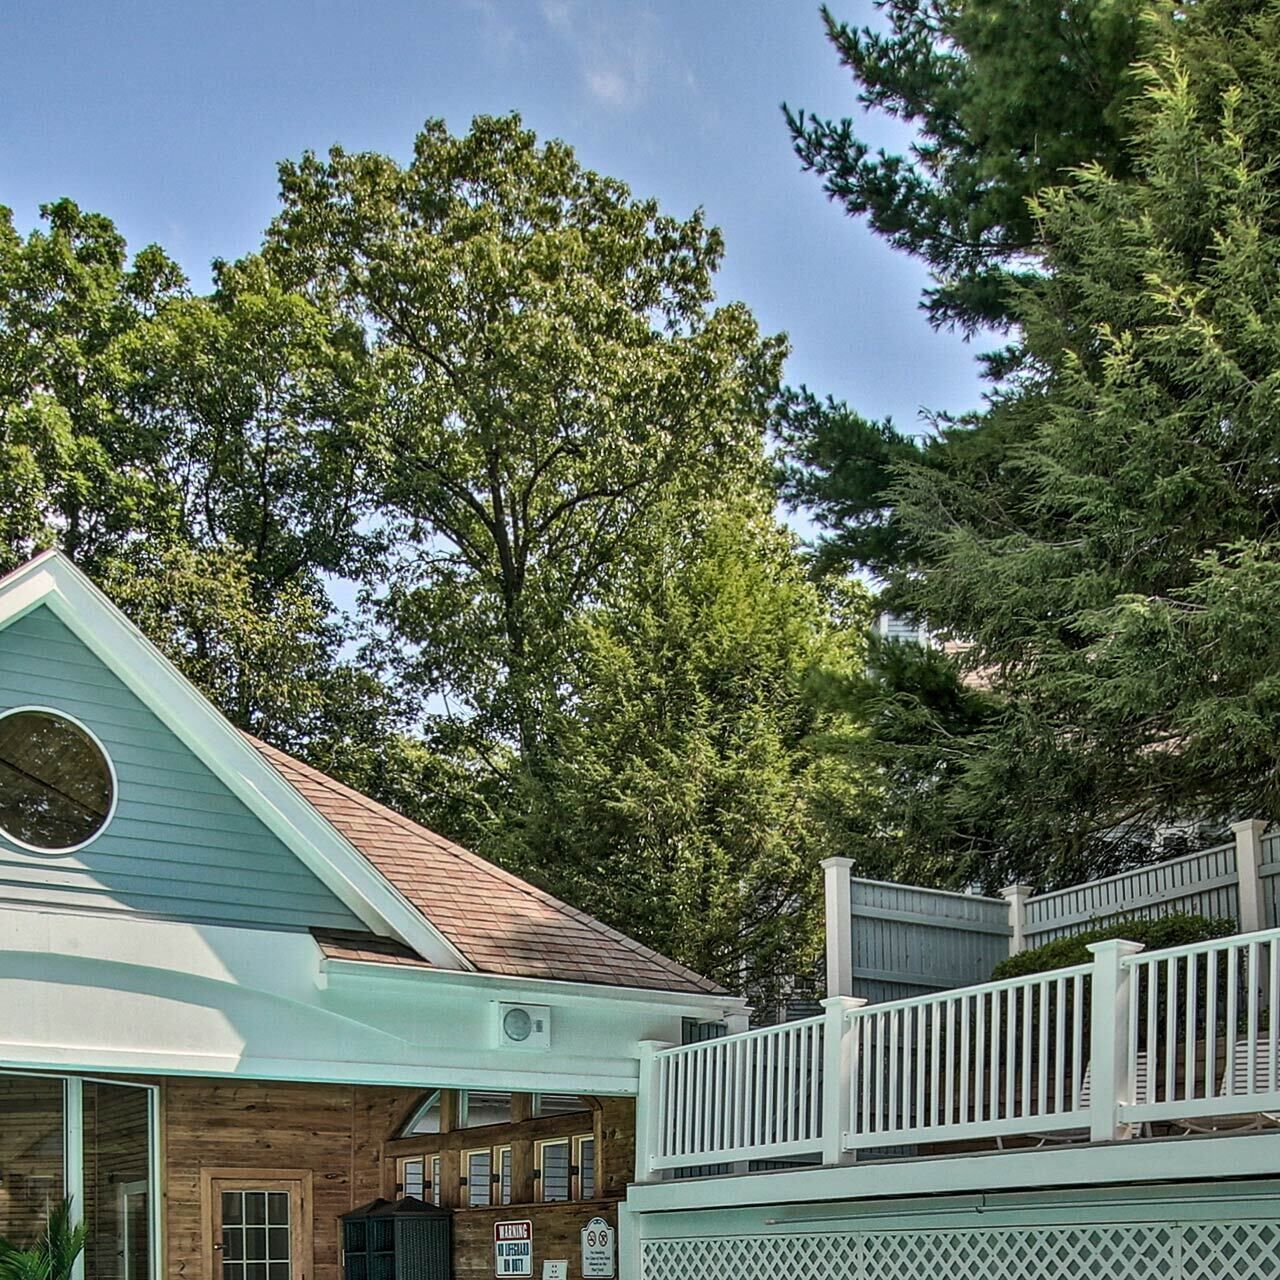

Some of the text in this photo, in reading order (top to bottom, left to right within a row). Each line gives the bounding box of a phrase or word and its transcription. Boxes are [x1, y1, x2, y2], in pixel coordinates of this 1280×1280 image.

[499, 1224, 528, 1239] WARNING
[498, 1242, 529, 1256] NO LIFEGUARD
[504, 1258, 524, 1273] ON DUTY
